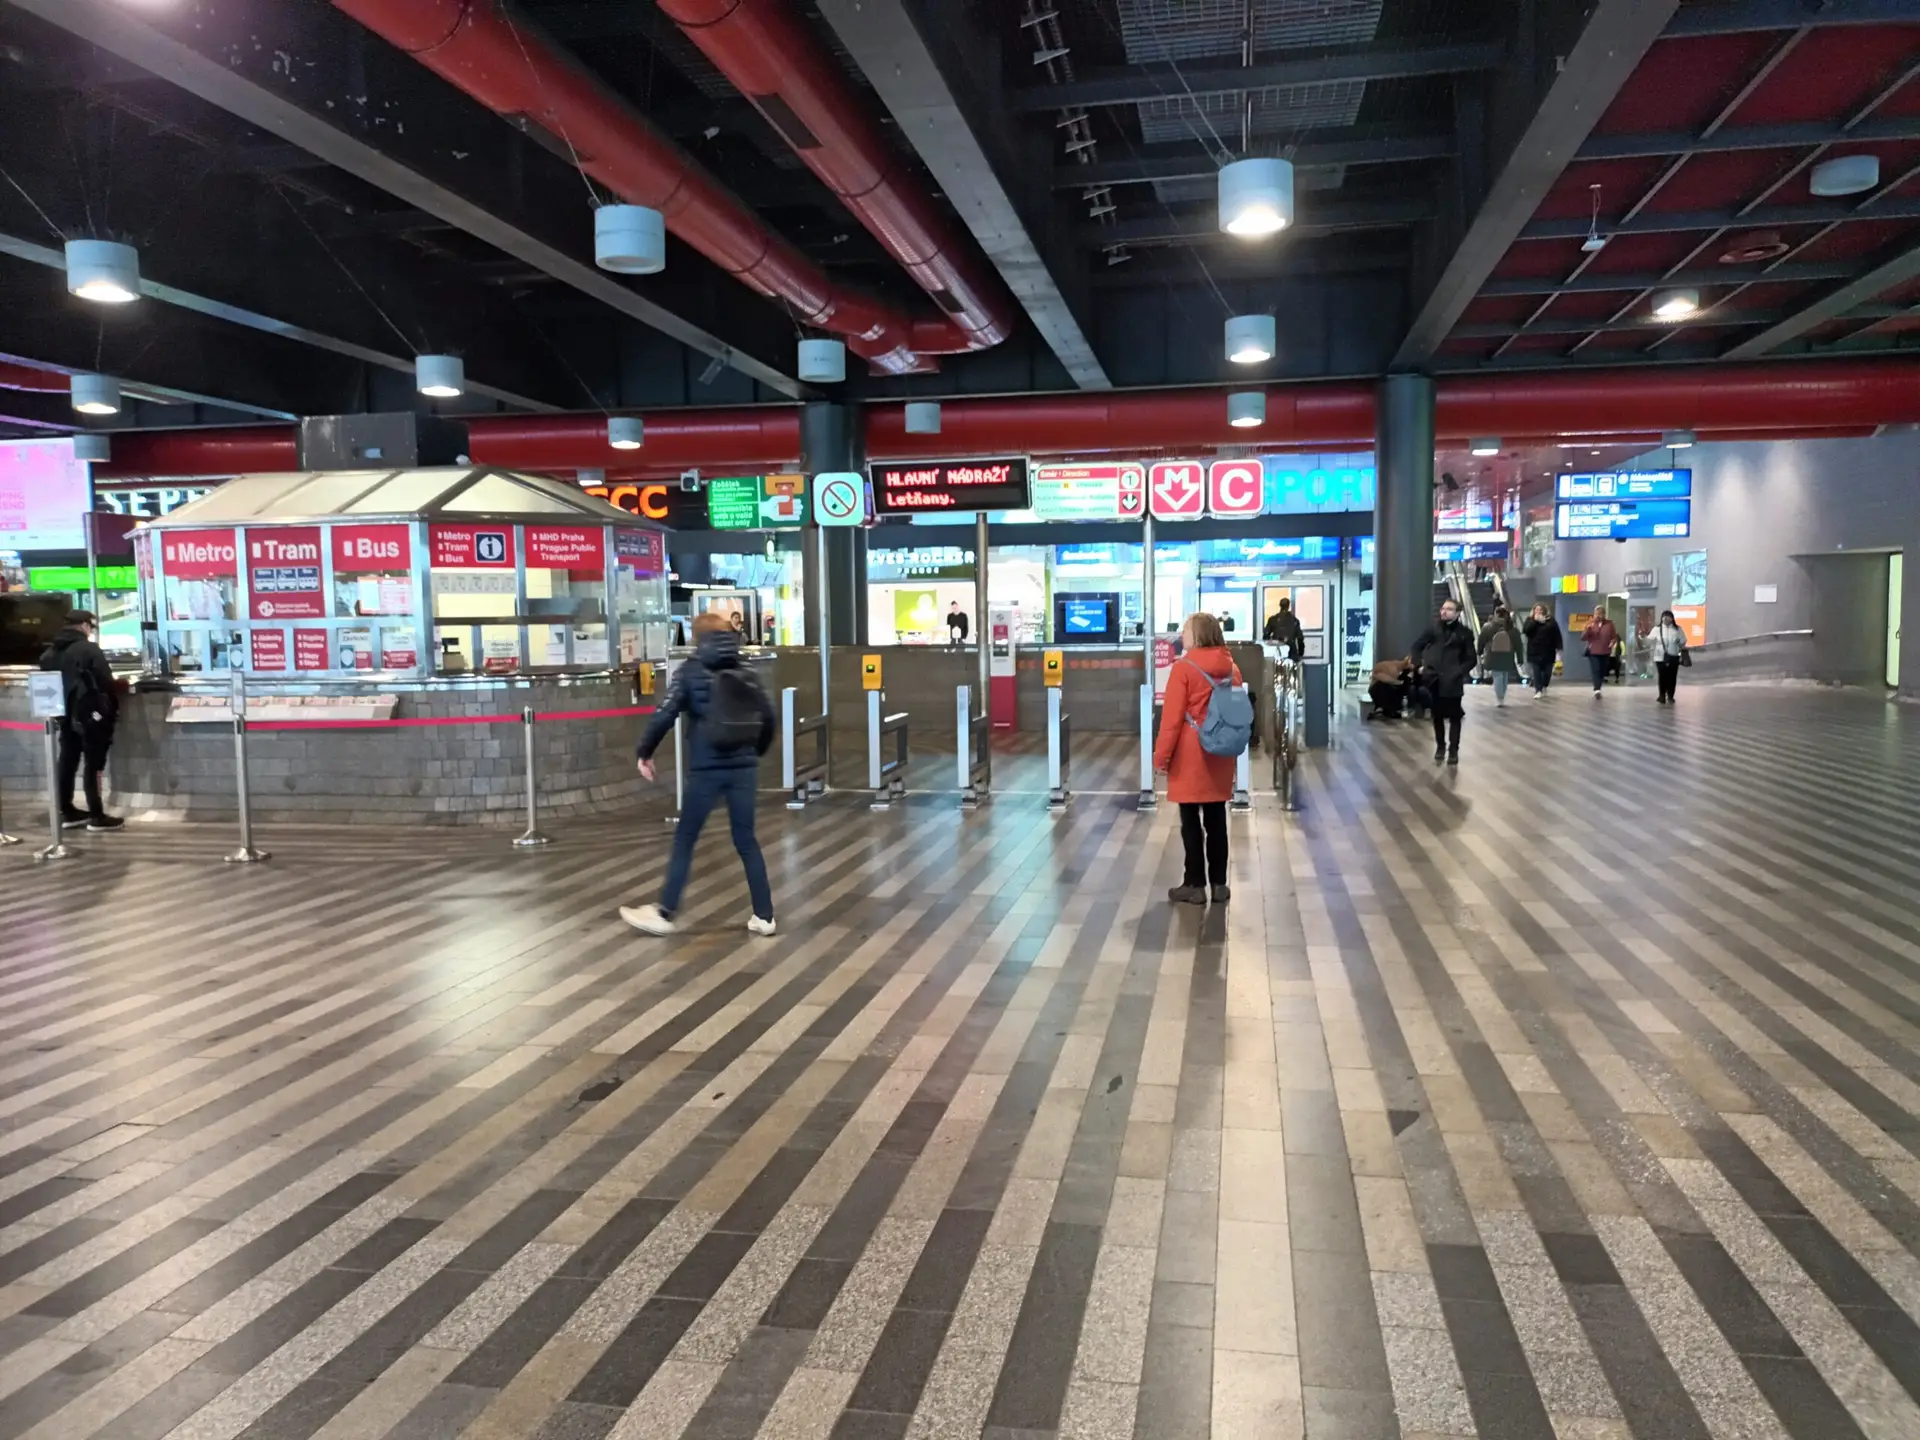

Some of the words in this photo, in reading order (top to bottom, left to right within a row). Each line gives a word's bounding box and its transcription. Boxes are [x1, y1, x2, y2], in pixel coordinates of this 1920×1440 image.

[947, 465, 1011, 485] NÁDRAŽÍ
[1219, 468, 1254, 508] C
[443, 531, 471, 541] Metro
[539, 532, 560, 541] MHD
[561, 532, 585, 541] Praha
[264, 540, 318, 560] Tram
[357, 538, 400, 558] Bus
[444, 542, 469, 551] Tram
[540, 543, 569, 553] Prague
[571, 543, 597, 552] Public
[178, 542, 235, 562] Metro
[541, 552, 580, 562] Transport
[444, 553, 464, 563] Bus
